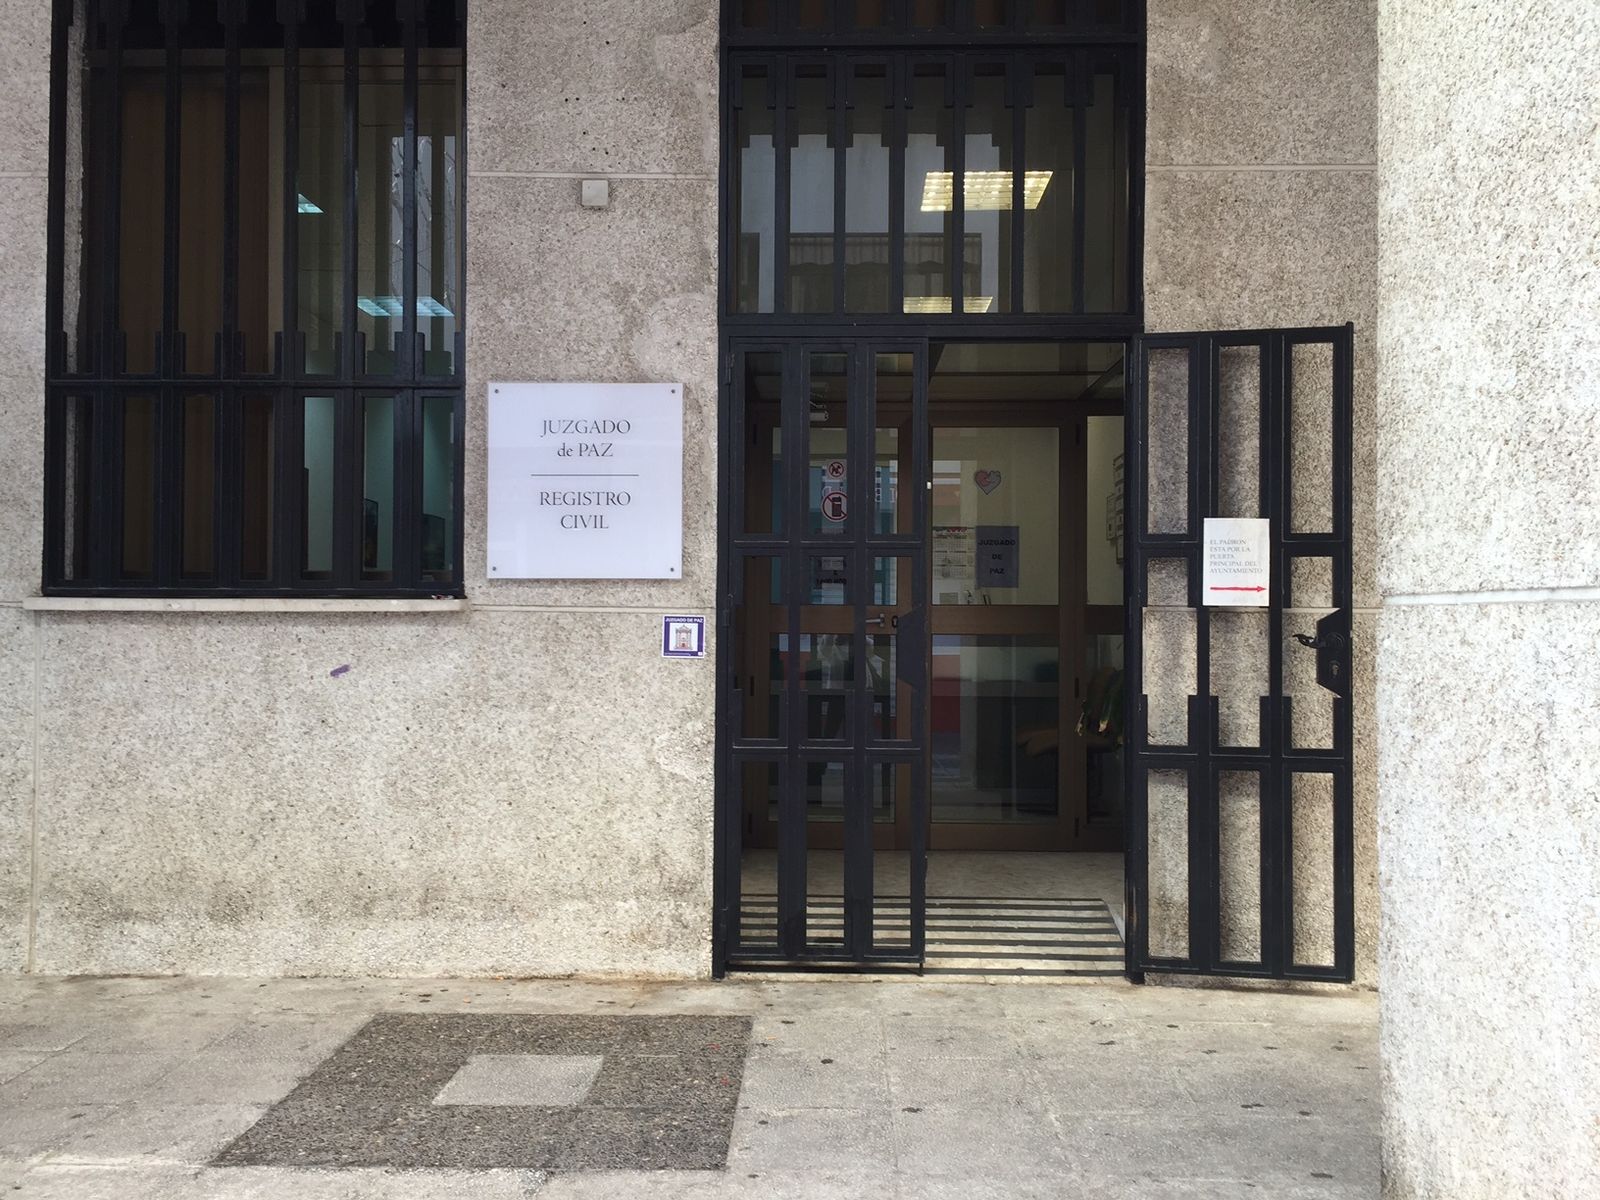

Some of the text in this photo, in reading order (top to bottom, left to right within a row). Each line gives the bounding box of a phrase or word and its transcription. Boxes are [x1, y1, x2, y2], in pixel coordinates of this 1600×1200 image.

[540, 419, 631, 438] JUZGADO
[557, 442, 614, 457] de PAZ
[539, 491, 631, 506] REGISTRO
[560, 513, 610, 529] CIVIL
